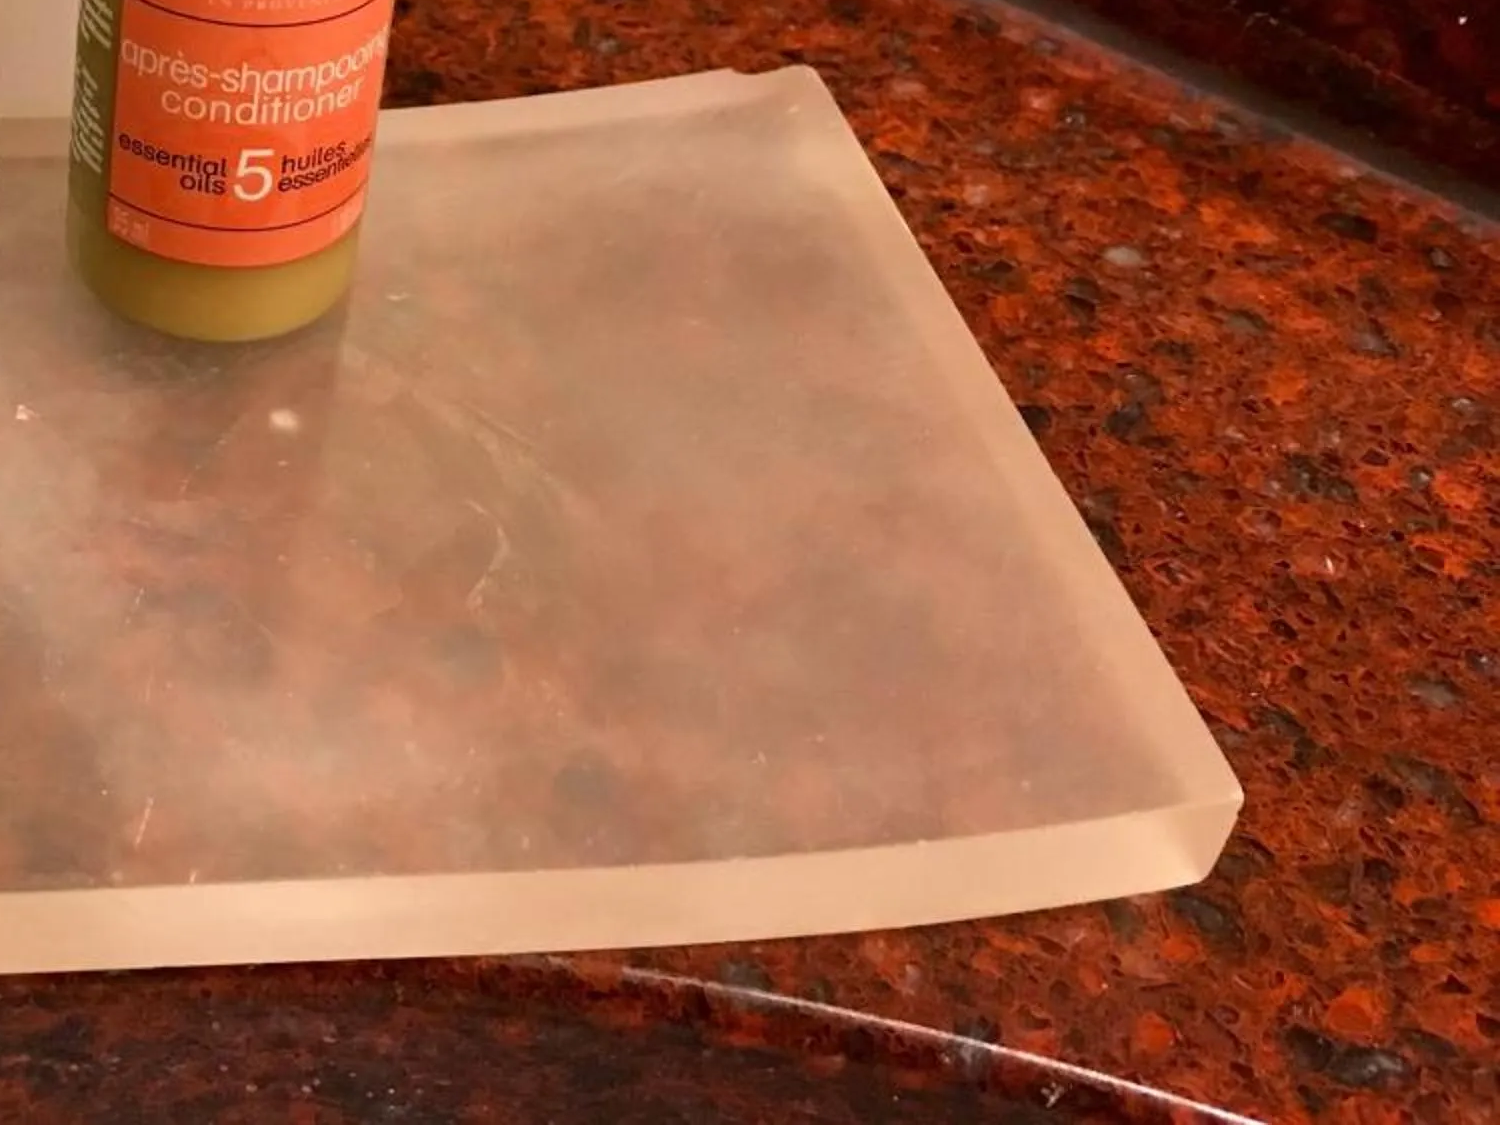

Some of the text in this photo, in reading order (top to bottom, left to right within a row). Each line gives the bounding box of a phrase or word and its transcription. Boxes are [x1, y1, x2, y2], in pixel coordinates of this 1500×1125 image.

[161, 78, 364, 127] conditioner
[118, 132, 347, 202] essential 5 huiles
[179, 131, 373, 195] oils essentie
